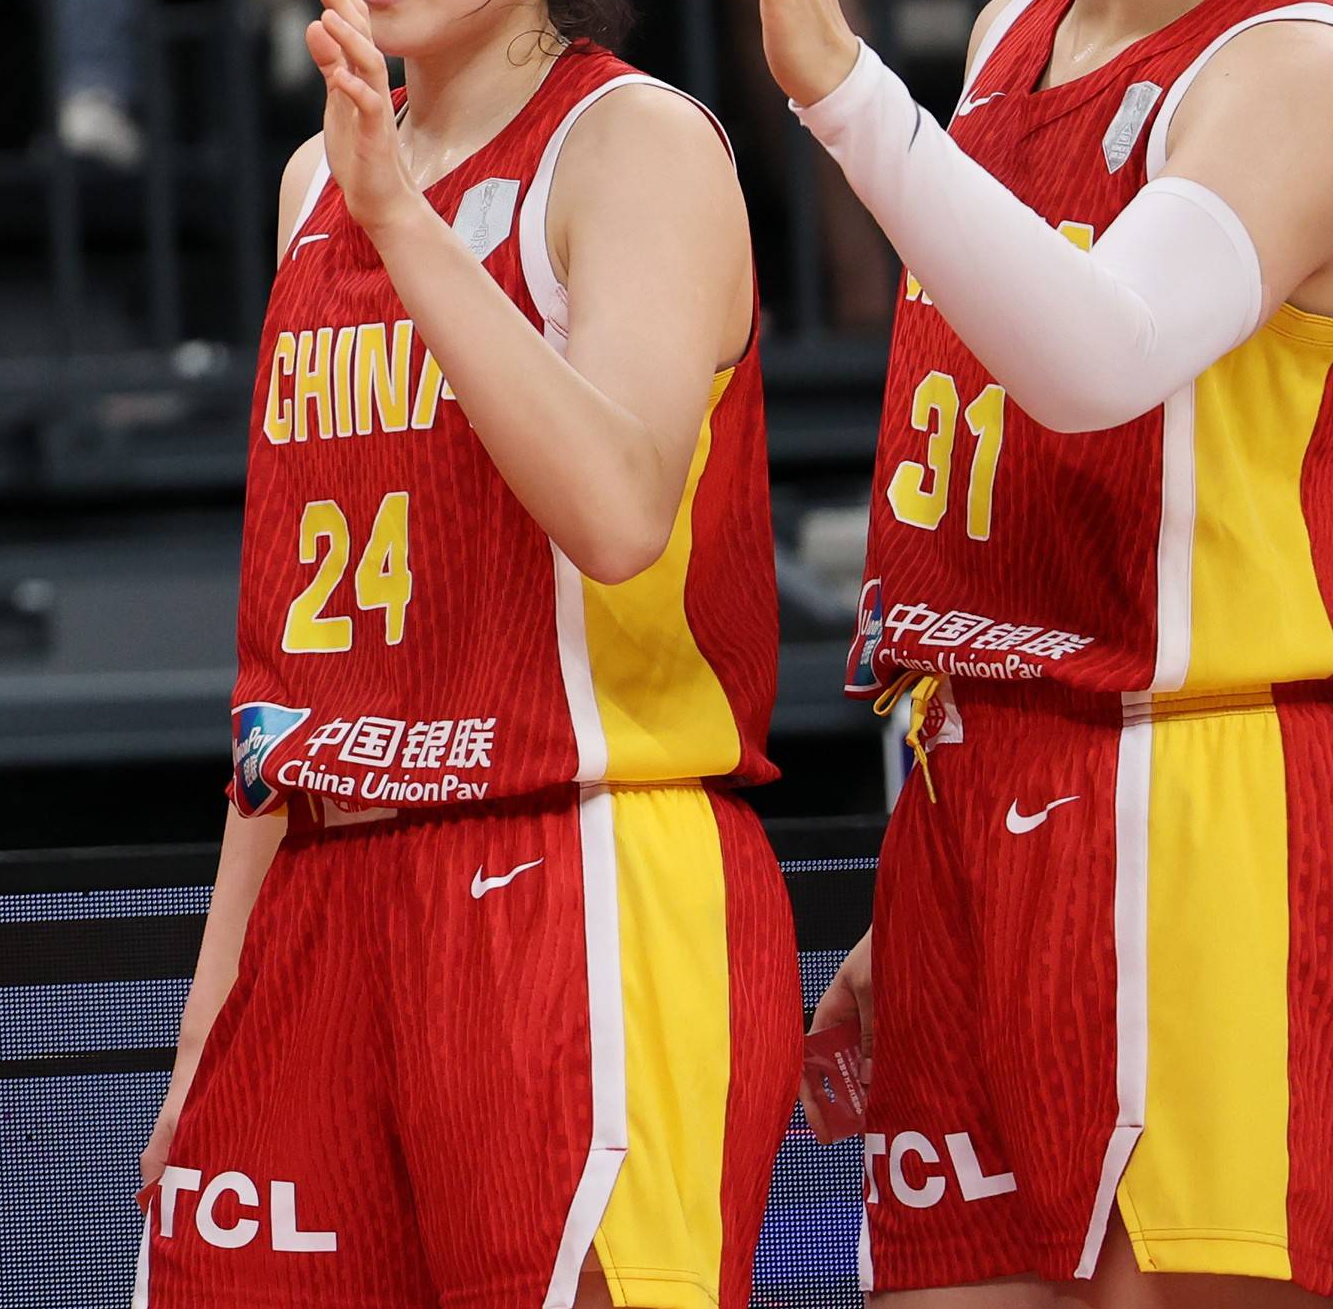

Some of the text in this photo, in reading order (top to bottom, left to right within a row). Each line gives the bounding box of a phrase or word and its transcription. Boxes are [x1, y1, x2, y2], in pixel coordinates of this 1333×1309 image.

[887, 370, 1006, 541] 31
[282, 492, 412, 654] 24
[885, 603, 1095, 659] 中国银联
[277, 760, 354, 796] China
[306, 716, 496, 769] 中国银联
[158, 1165, 338, 1253] TCL
[865, 1130, 1018, 1209] TCL
